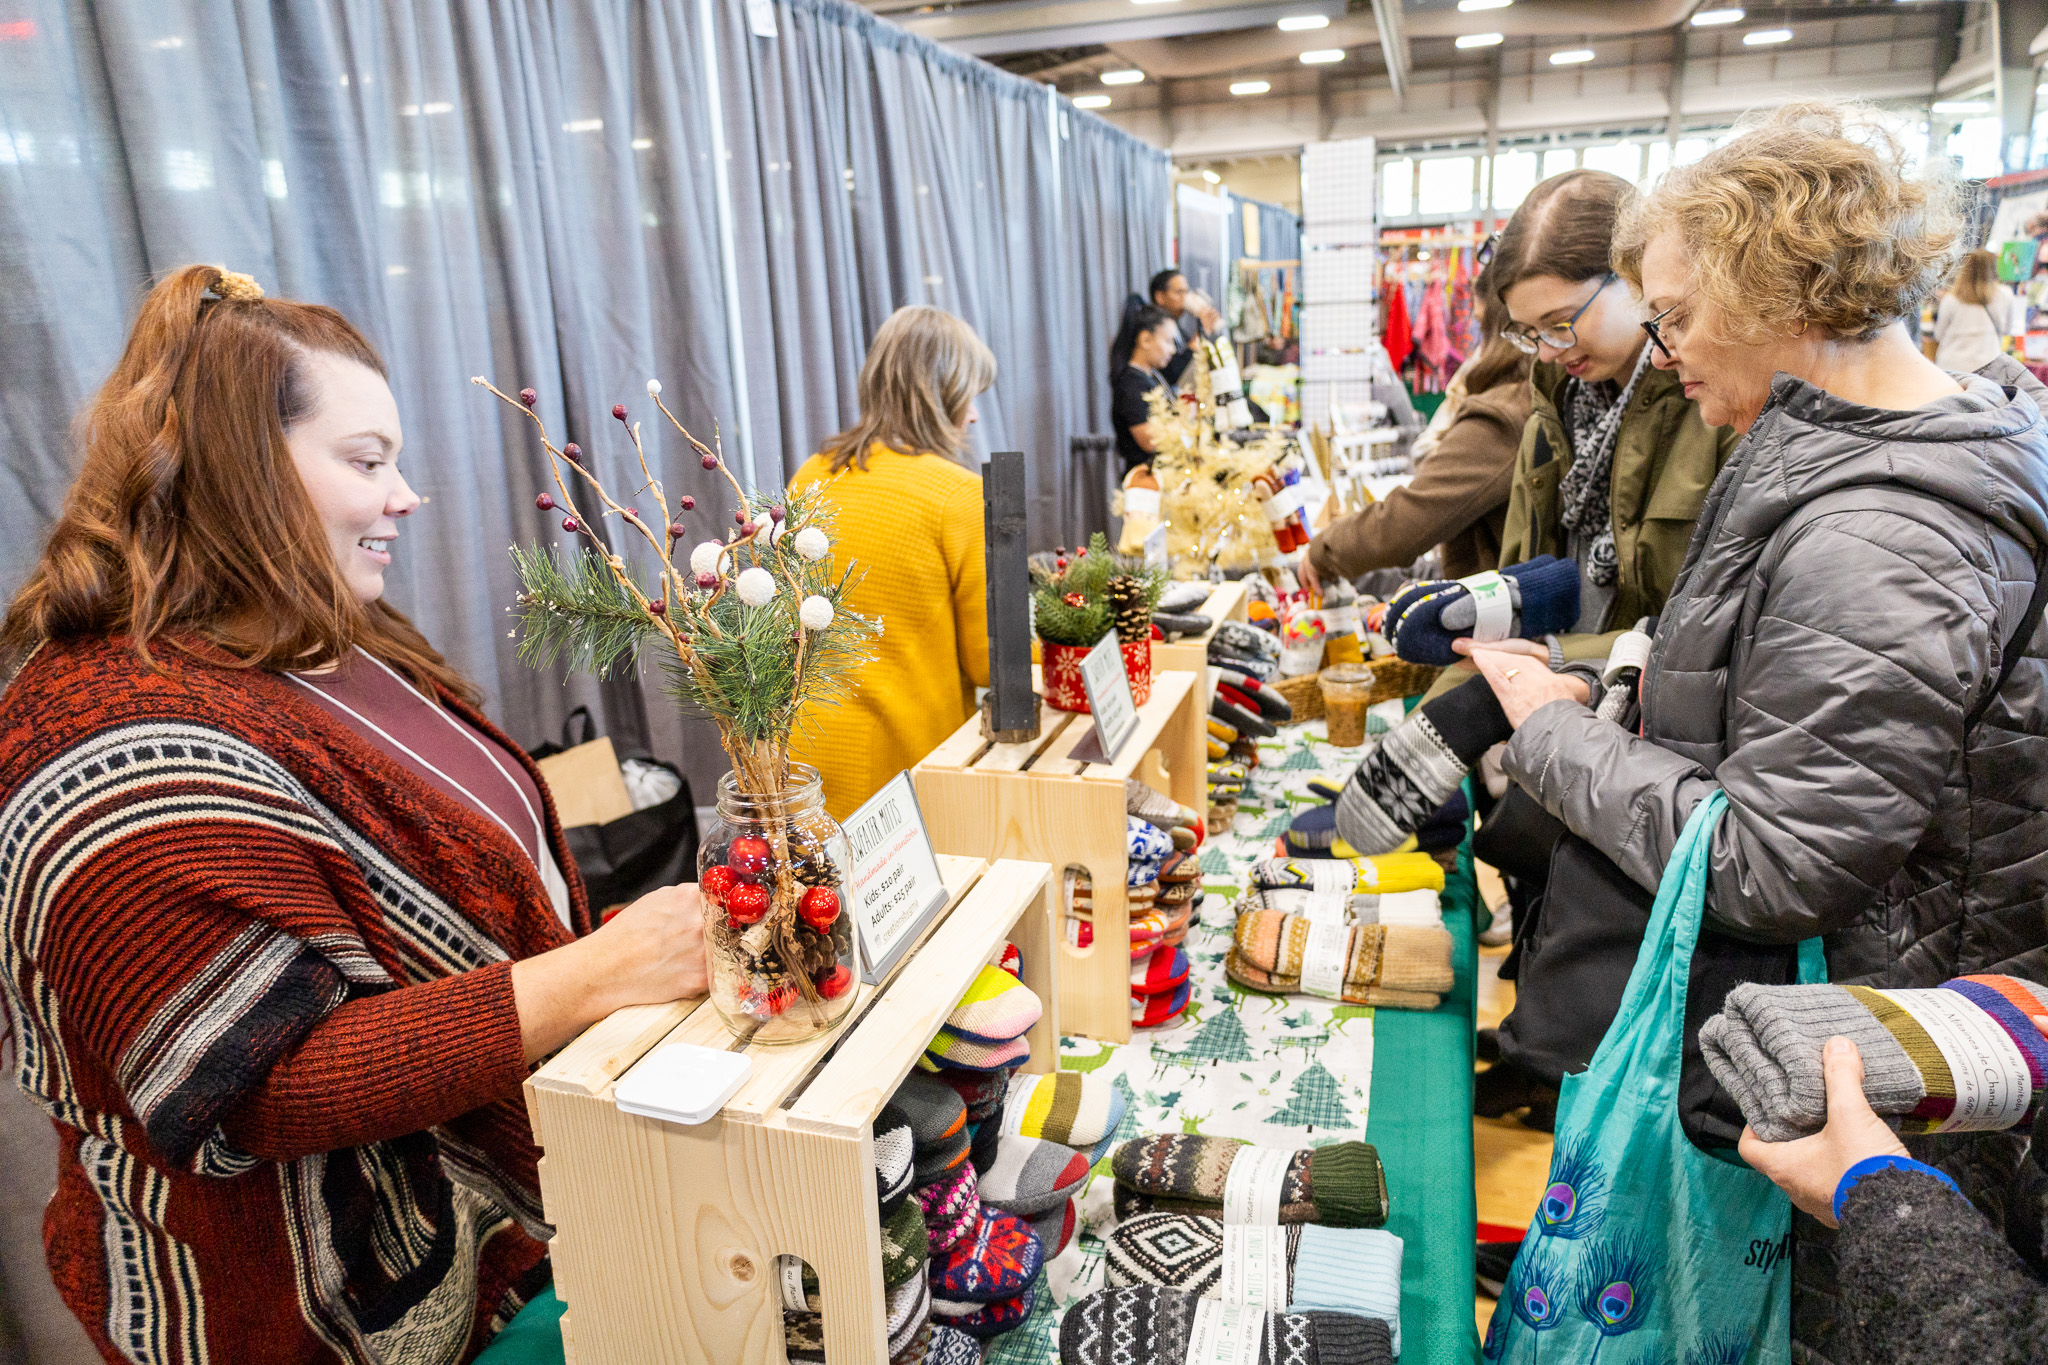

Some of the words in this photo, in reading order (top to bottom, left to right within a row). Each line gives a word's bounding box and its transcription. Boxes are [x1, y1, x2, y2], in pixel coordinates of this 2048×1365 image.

[848, 815, 884, 863] SWEATER
[878, 798, 902, 835] MITTS
[855, 856, 887, 891] Handmade
[887, 850, 894, 861] in
[893, 828, 918, 853] Manitoba
[863, 888, 881, 908] Kids:
[881, 876, 893, 892] $10
[892, 863, 905, 884] pair
[871, 900, 894, 928] Adults:
[893, 888, 906, 904] $25
[904, 875, 916, 896] pair
[1943, 1013, 1980, 1050] Mitaines
[1977, 1050, 1990, 1066] de
[2009, 1055, 2018, 1067] au
[1966, 1080, 1975, 1092] de
[1245, 1187, 1254, 1224] Sweater
[1247, 1273, 1263, 1297] MITTS
[1216, 1340, 1235, 1362] MITTS
